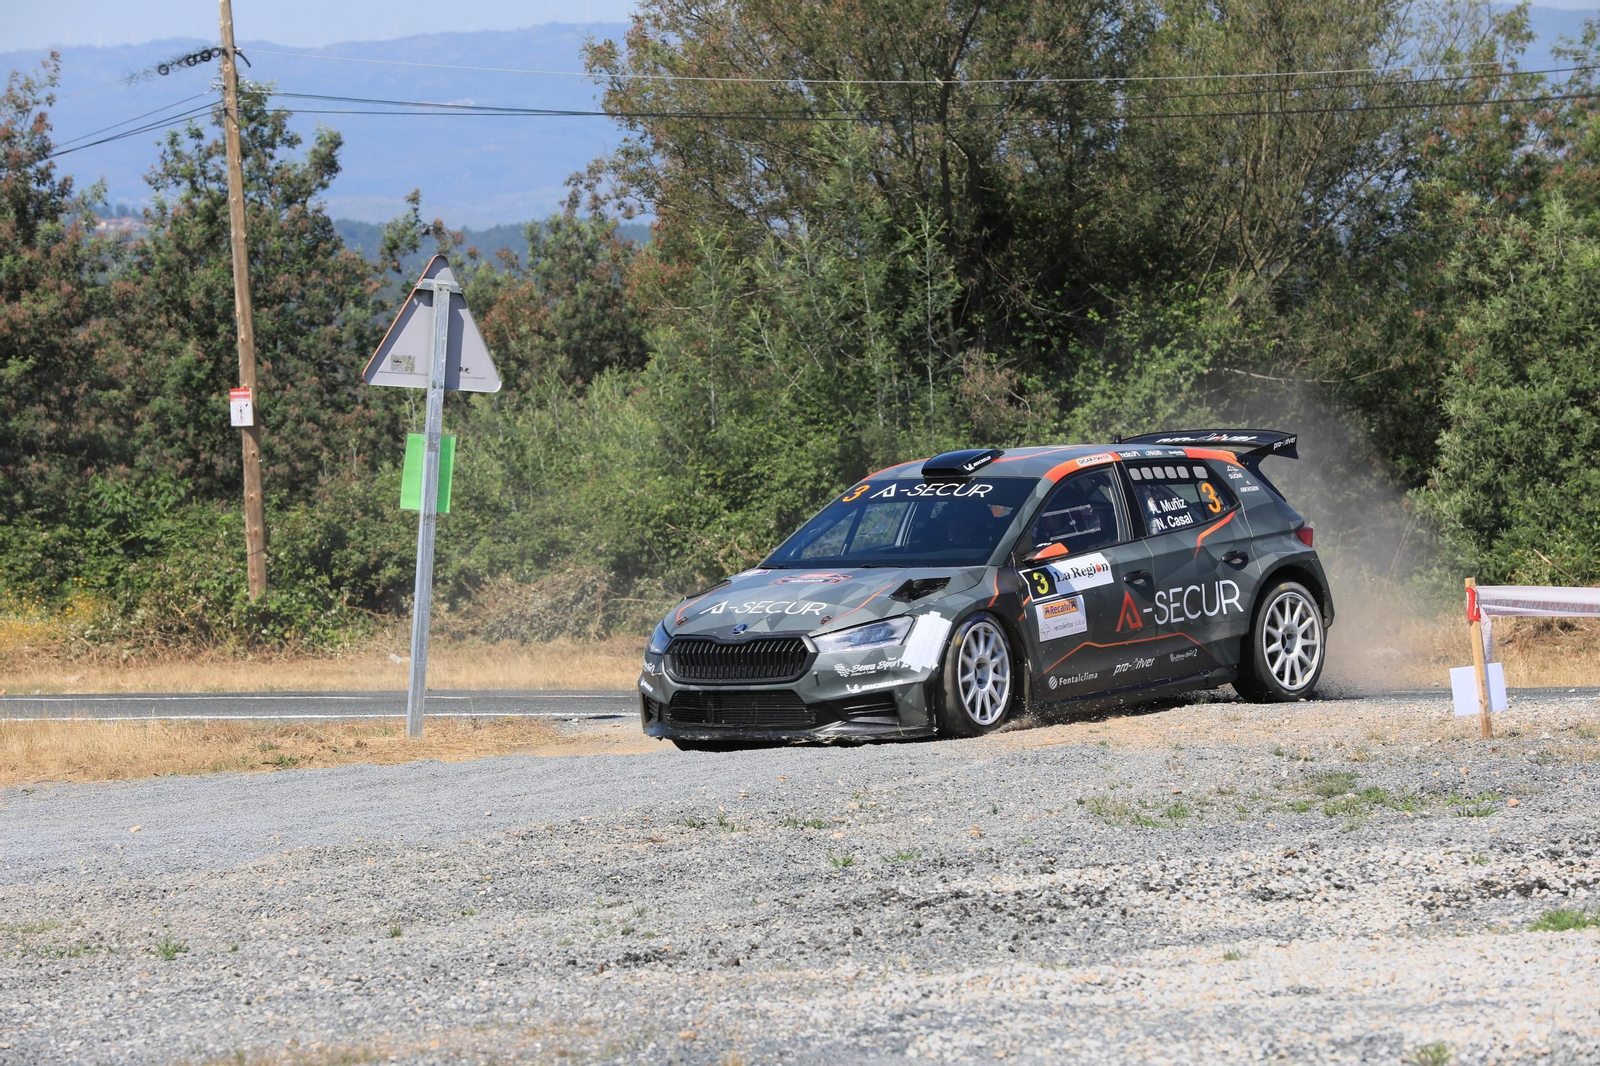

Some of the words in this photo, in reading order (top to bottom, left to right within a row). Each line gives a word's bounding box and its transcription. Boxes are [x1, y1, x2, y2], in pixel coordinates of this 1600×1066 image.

[843, 484, 871, 502] 3
[869, 483, 993, 499] A-SECUR
[1201, 482, 1221, 514] 3
[1160, 496, 1187, 513] Muñiz
[1155, 518, 1167, 531] N.
[1167, 512, 1193, 528] Casal
[1032, 572, 1049, 595] 3
[1054, 570, 1071, 583] La
[699, 600, 828, 616] A-SECUR
[1059, 673, 1099, 686] Fontalclima
